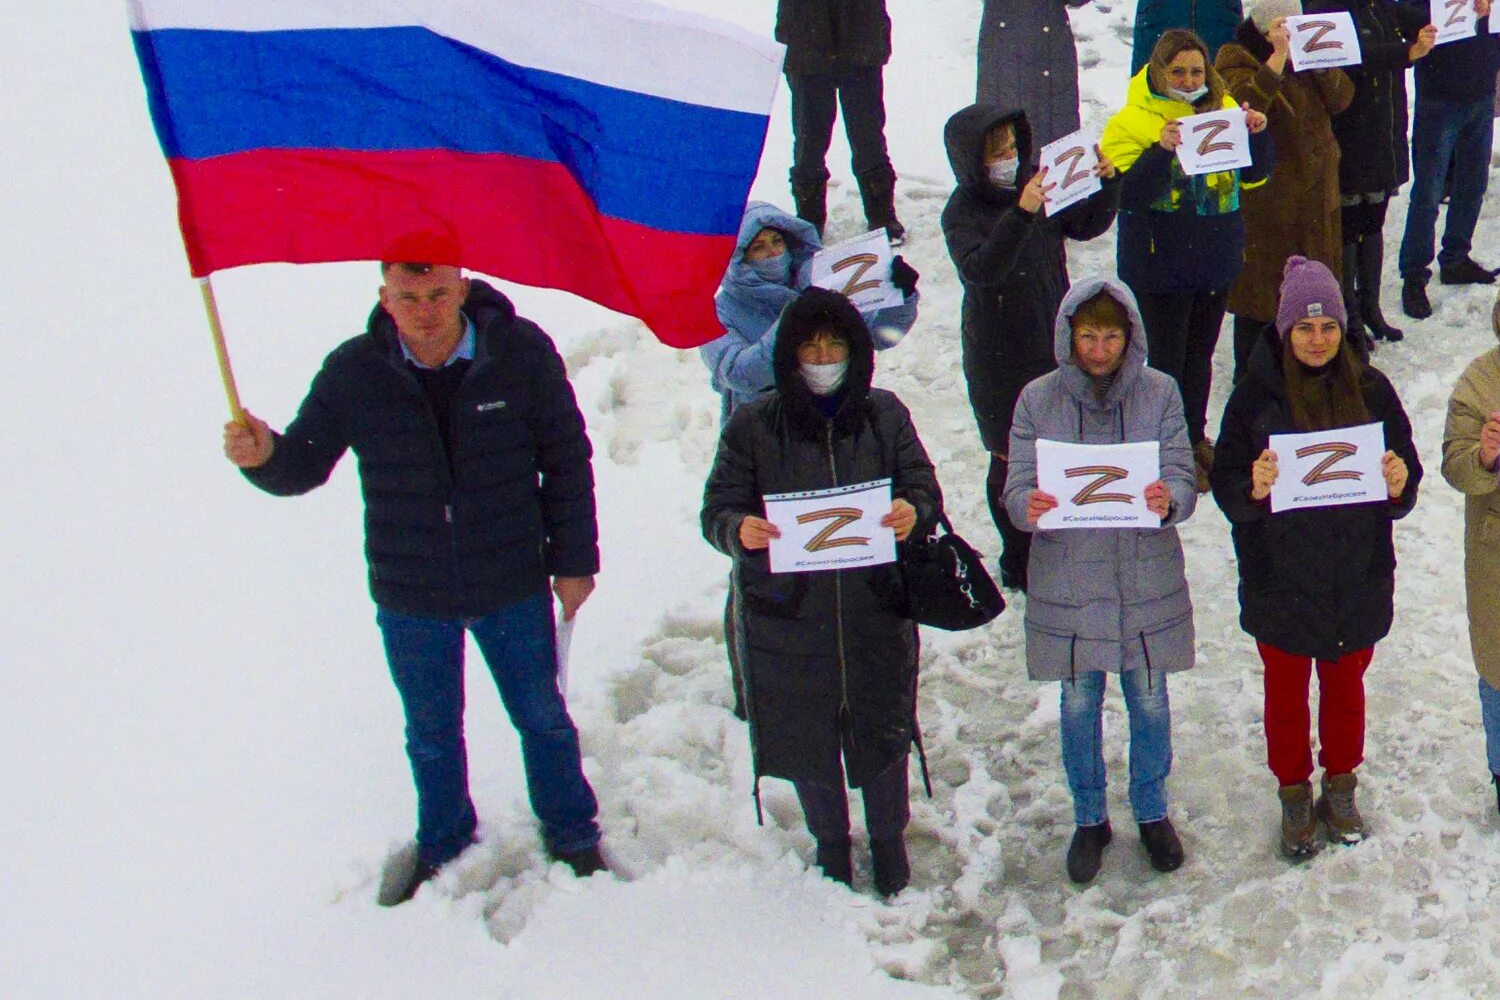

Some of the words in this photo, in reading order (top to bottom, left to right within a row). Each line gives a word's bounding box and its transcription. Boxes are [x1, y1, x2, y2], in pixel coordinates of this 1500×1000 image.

[1296, 20, 1344, 53] Z
[1193, 119, 1235, 156] Z
[1054, 146, 1091, 190] Z
[831, 253, 883, 297] Z
[1064, 465, 1136, 506] Z
[1295, 442, 1365, 486] Z
[795, 507, 872, 553] Z
